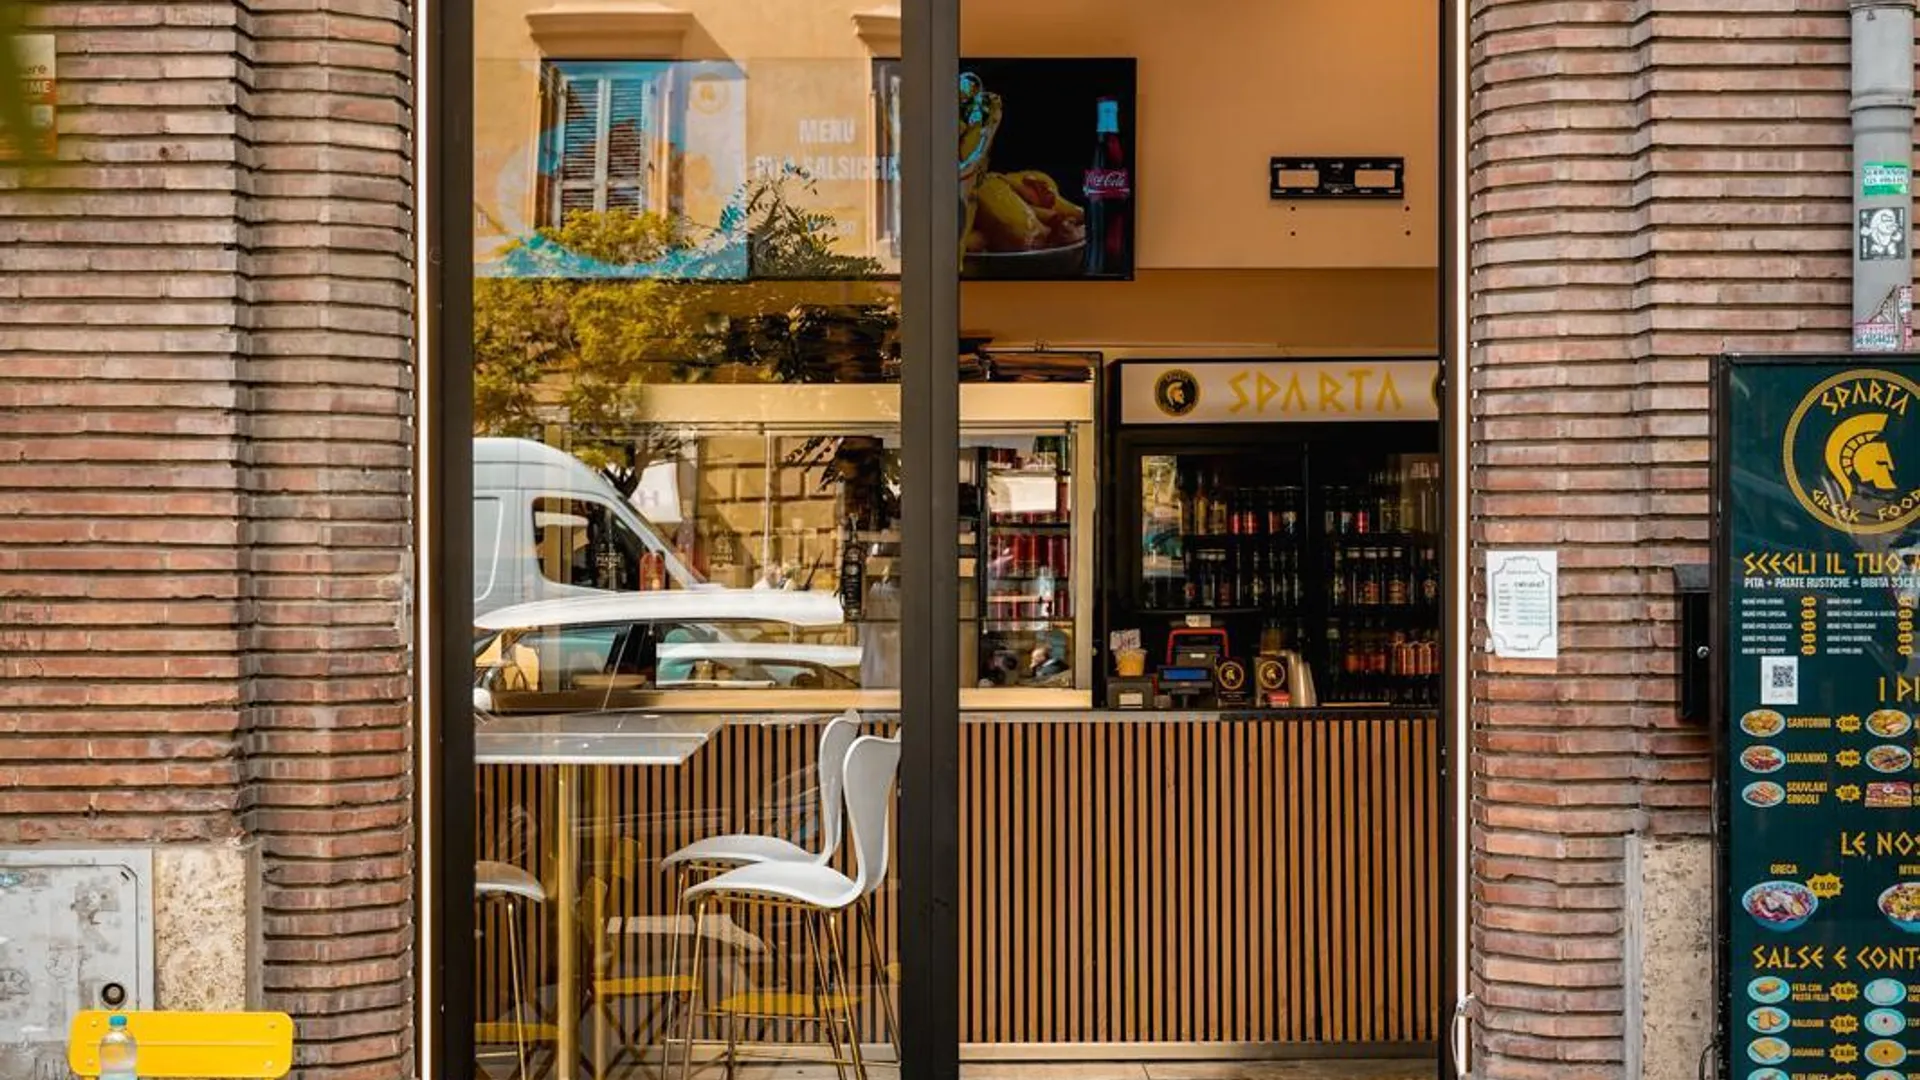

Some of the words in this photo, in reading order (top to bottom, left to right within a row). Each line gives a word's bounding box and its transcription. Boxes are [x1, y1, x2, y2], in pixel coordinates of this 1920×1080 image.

[1227, 366, 1405, 414] SPARTA
[1821, 379, 1909, 415] SPARTA
[1812, 489, 1861, 522] GREEK
[1743, 552, 1816, 575] SCEGLI
[1826, 552, 1846, 574] IL
[1854, 552, 1901, 574] TUO
[1744, 577, 1764, 588] PITA
[1840, 831, 1867, 856] LE
[1752, 944, 1824, 969] SALSE
[1832, 945, 1847, 969] E
[1856, 945, 1920, 969] CONT
